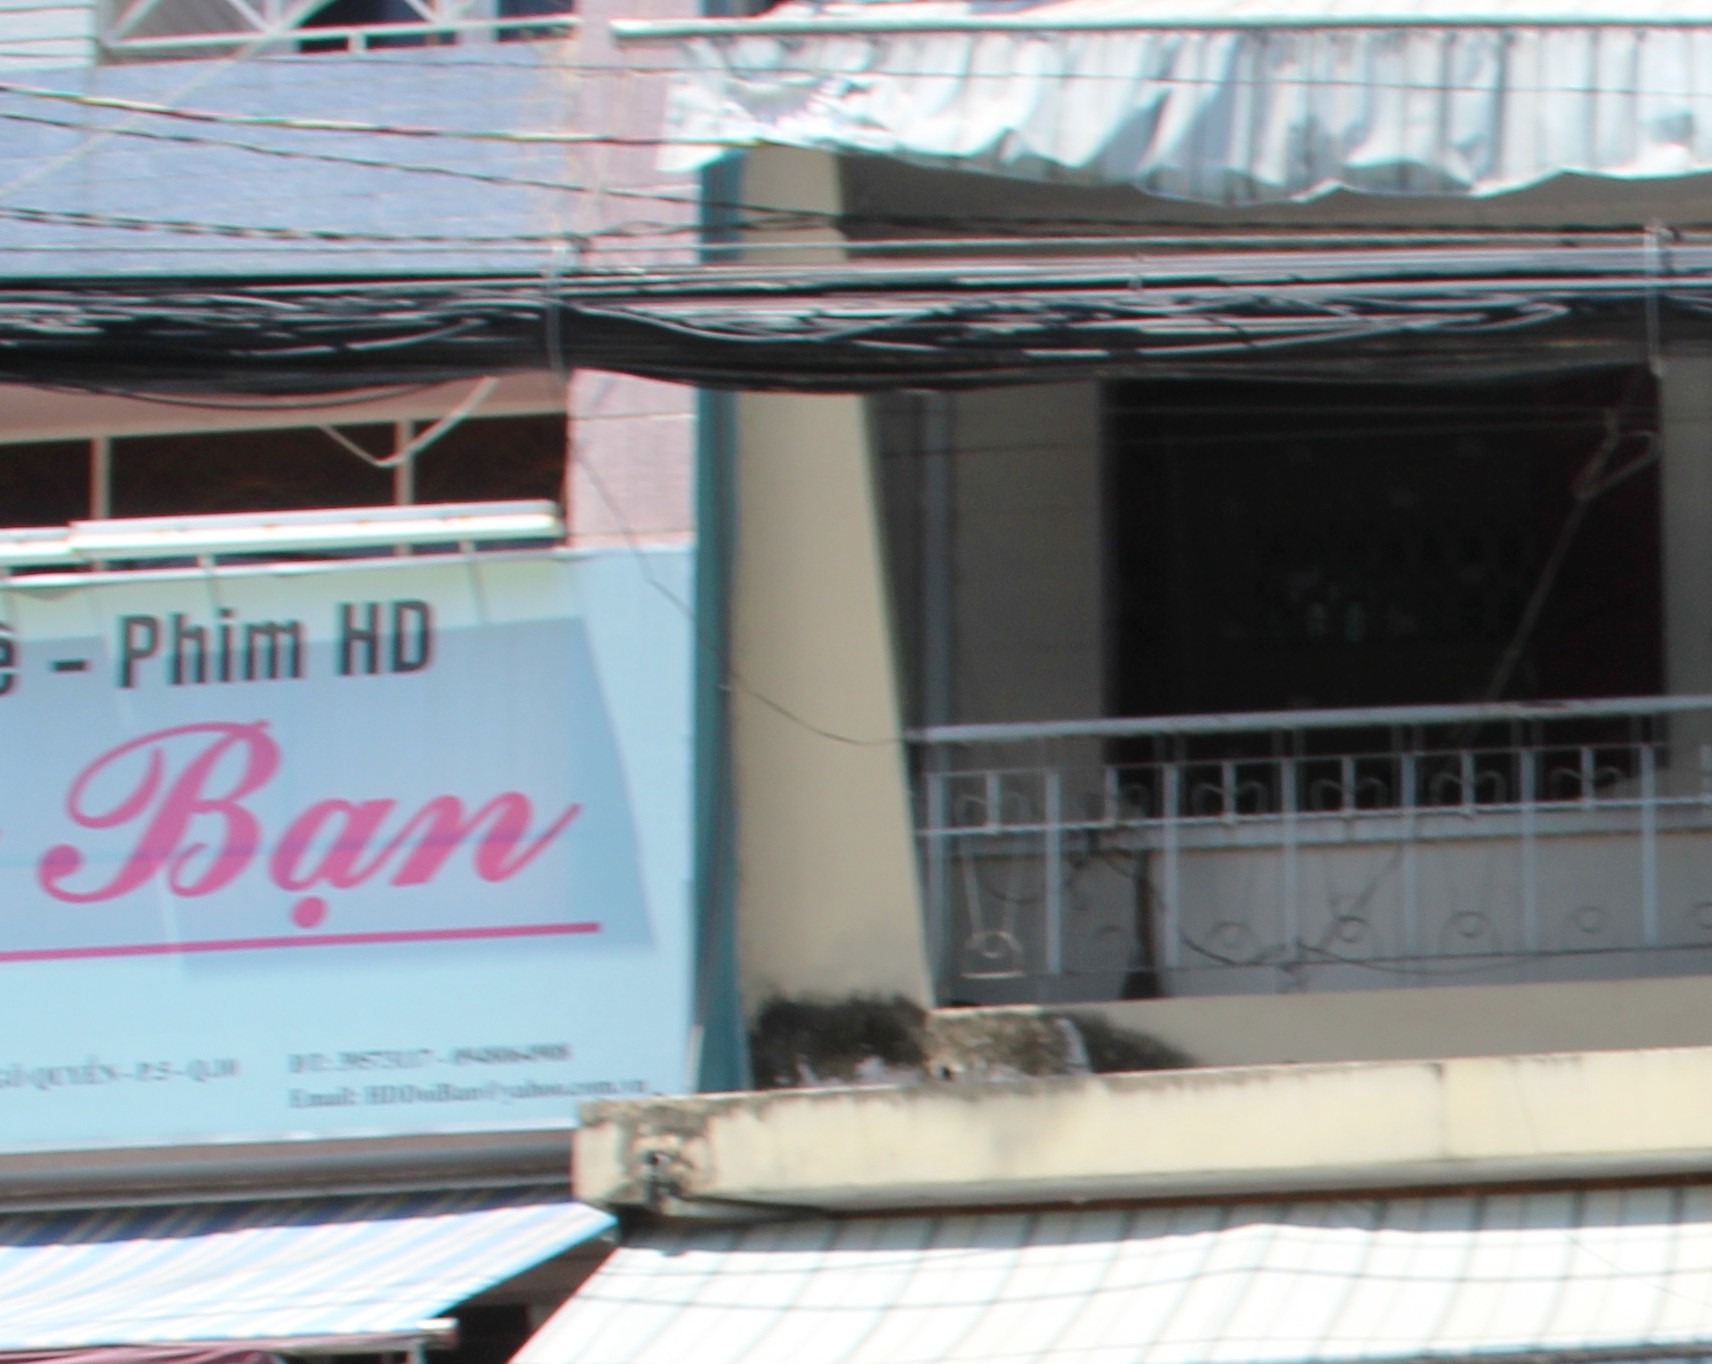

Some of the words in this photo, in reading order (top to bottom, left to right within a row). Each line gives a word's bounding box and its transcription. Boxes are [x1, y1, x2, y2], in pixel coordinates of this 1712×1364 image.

[117, 608, 306, 689] Phim
[336, 600, 436, 677] HD
[37, 719, 583, 929] Bạn
